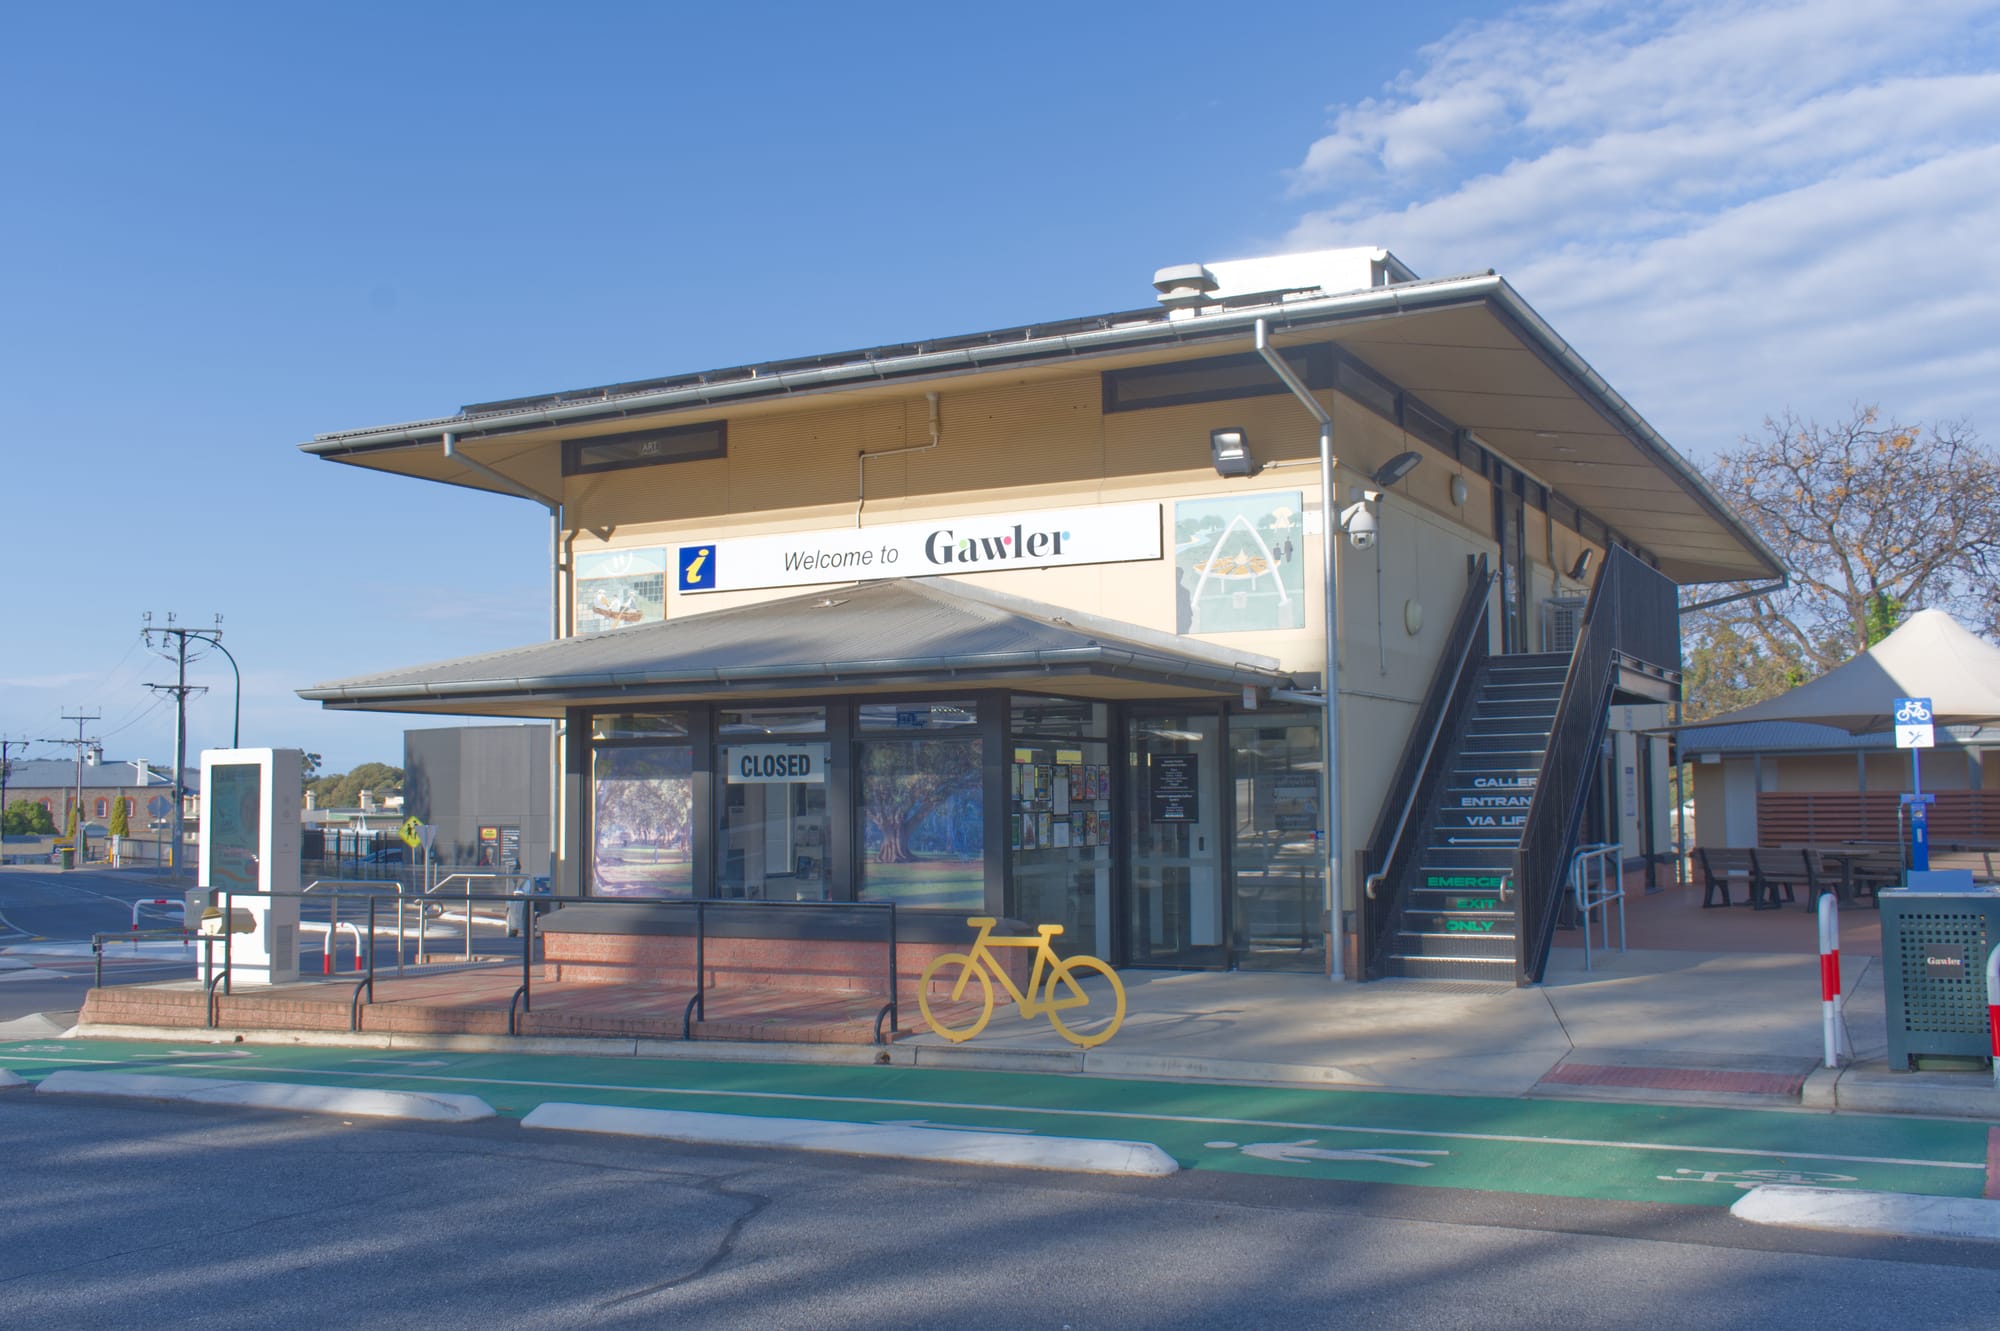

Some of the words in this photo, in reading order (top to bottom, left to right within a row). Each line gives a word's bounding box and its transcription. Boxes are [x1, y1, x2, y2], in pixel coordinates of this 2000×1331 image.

[925, 524, 1071, 565] Gawler
[784, 550, 874, 572] Welcome
[880, 546, 899, 564] to
[740, 754, 811, 778] CLOSED
[1474, 777, 1537, 787] GALLER
[1461, 796, 1533, 806] ENTRAN
[1466, 816, 1496, 825] VIA
[1502, 816, 1527, 825] LIF
[1456, 898, 1497, 909] EXIT
[1446, 920, 1495, 931] ONLY
[1927, 956, 1964, 966] Gawler
